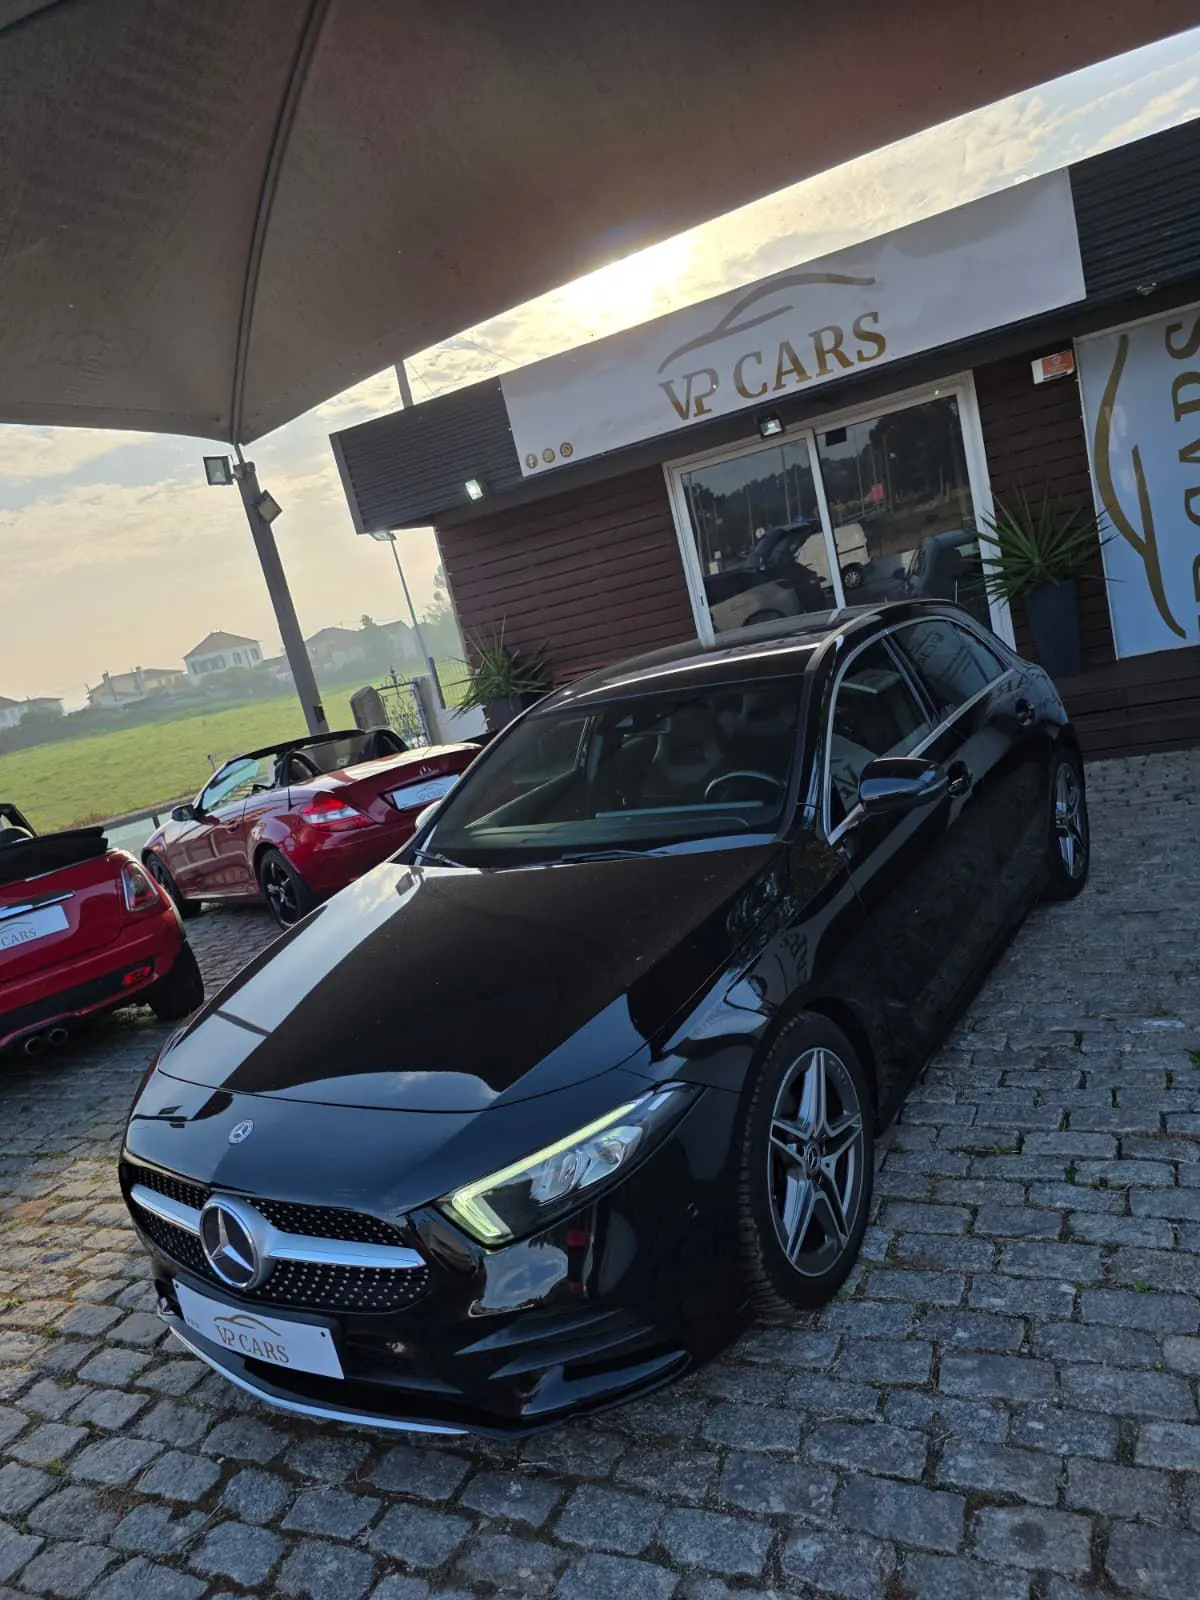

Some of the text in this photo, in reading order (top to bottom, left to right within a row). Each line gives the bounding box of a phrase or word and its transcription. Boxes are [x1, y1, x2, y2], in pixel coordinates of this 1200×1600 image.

[658, 312, 887, 420] VP CARS
[1, 927, 37, 947] CARS
[214, 1324, 290, 1363] VP CARS
